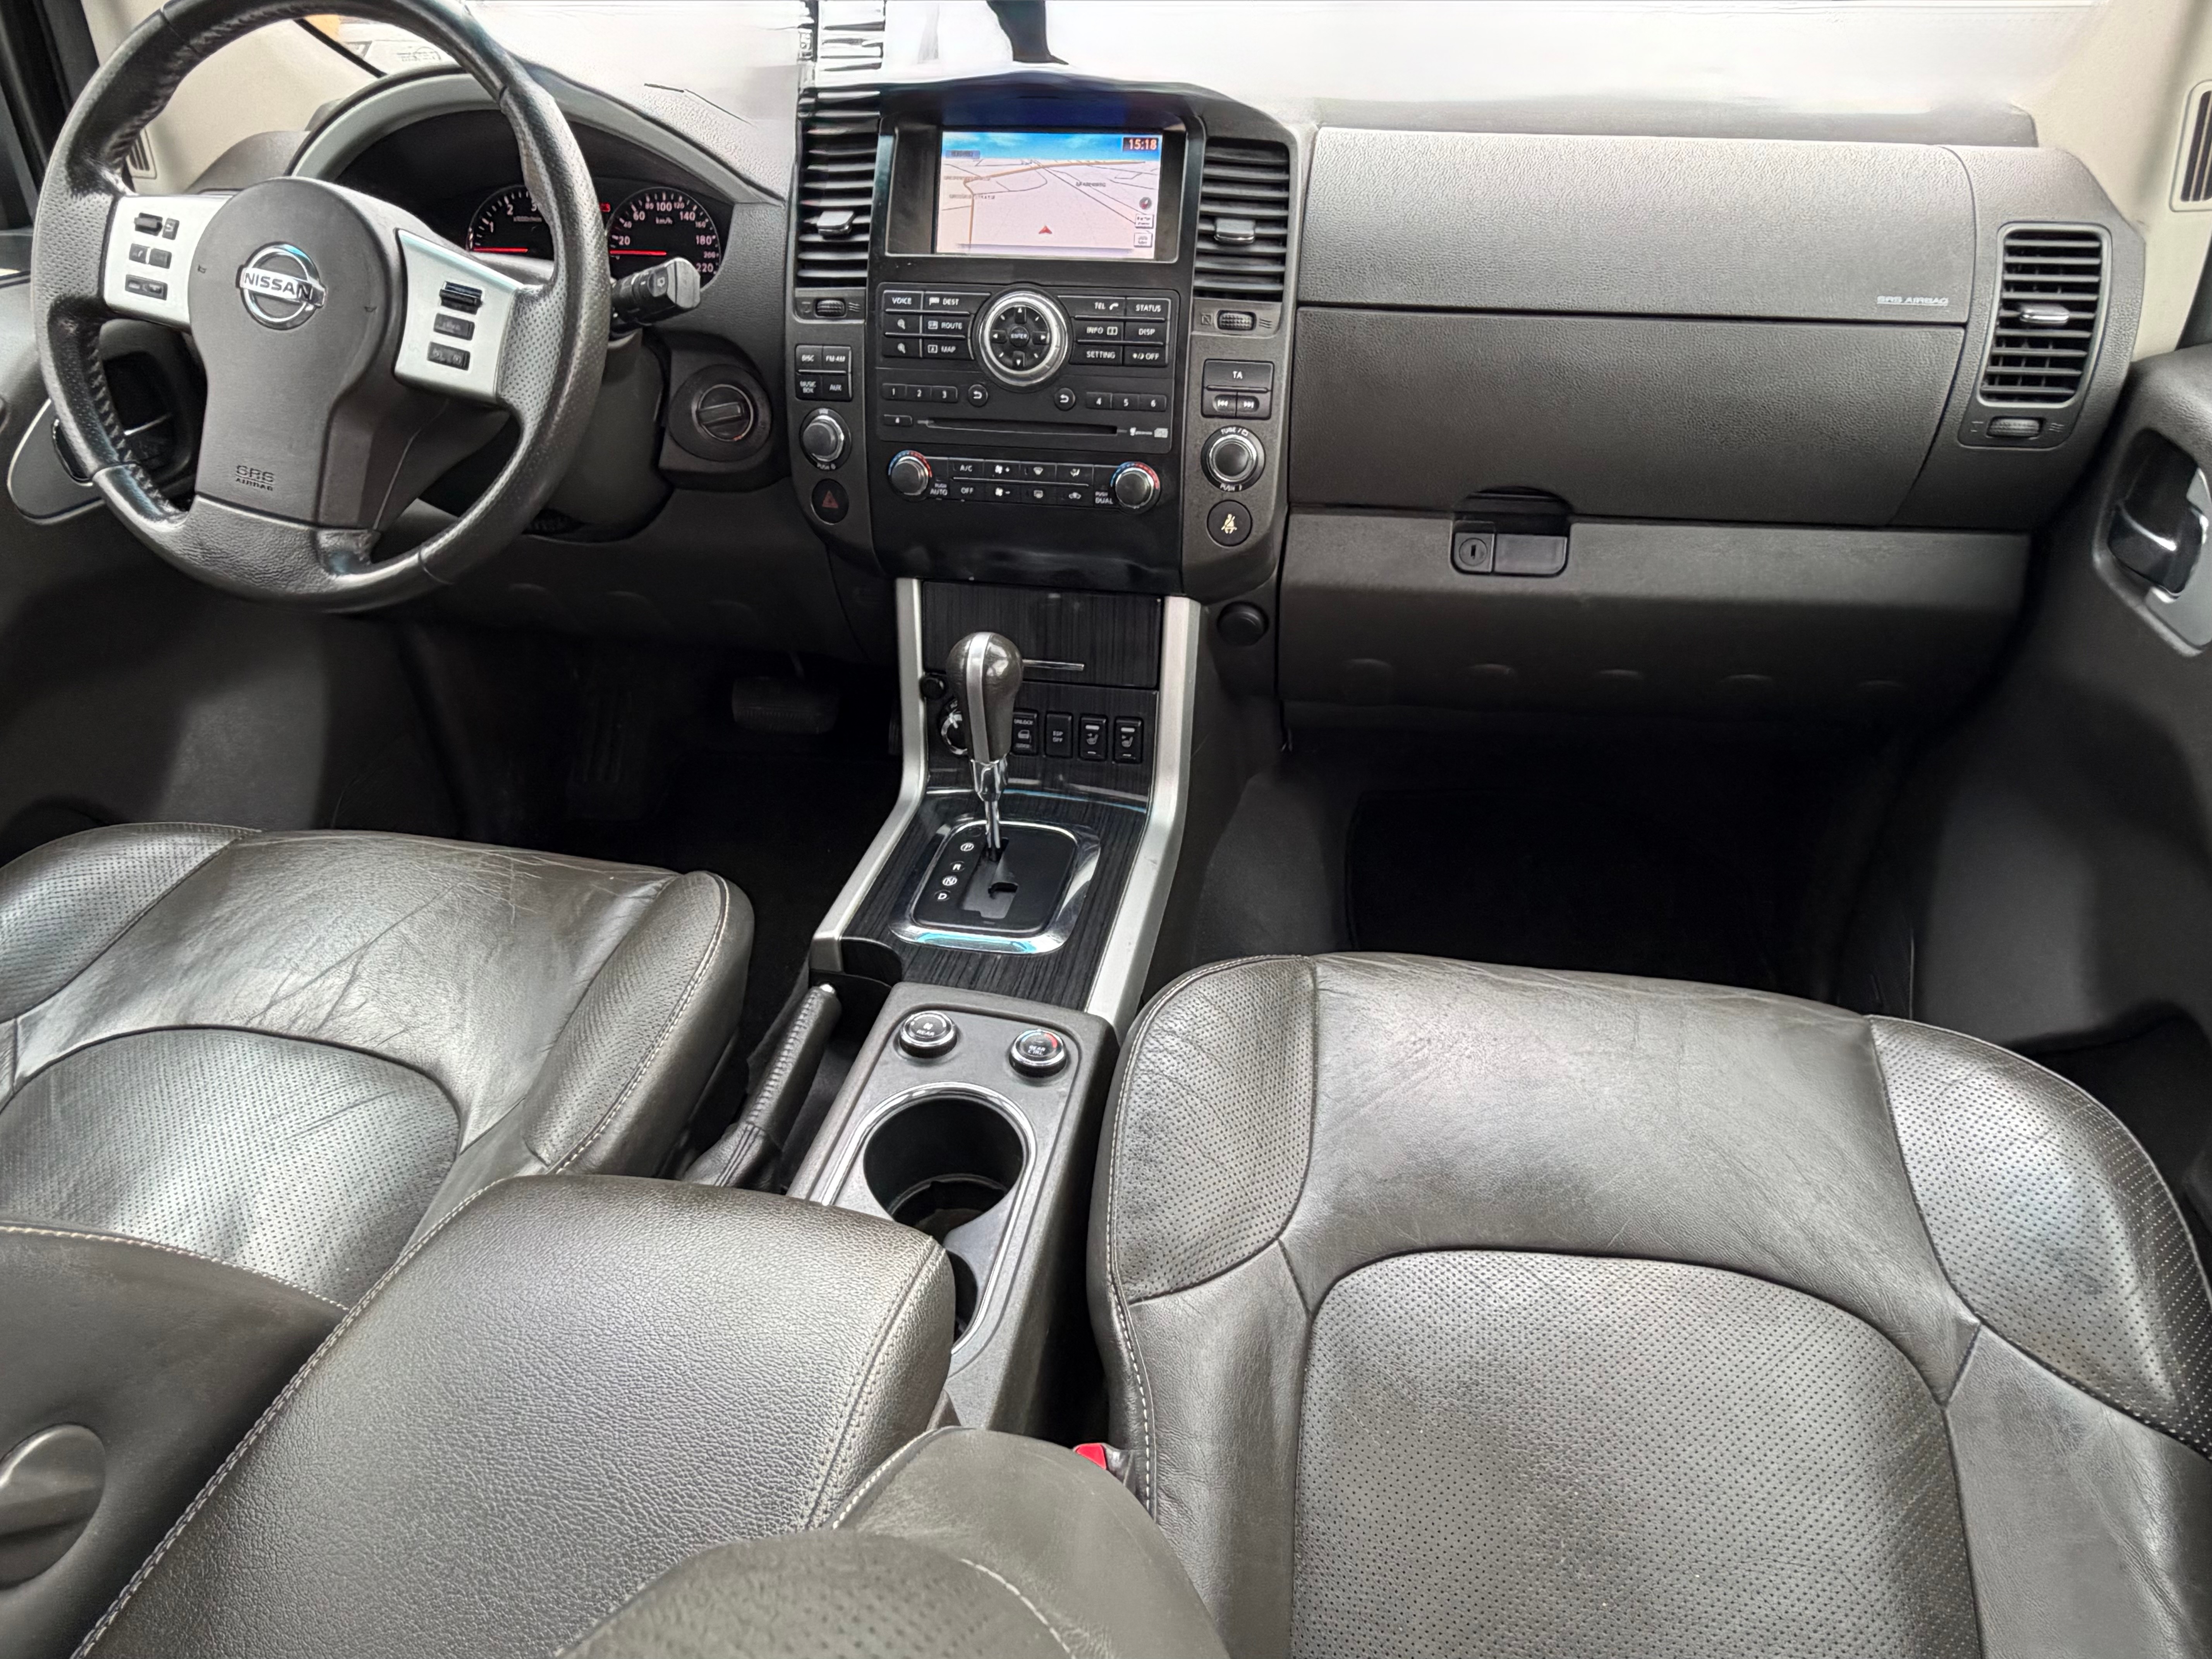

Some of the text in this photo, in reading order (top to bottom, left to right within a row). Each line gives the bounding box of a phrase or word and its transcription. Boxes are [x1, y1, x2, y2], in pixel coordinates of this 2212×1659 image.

[1129, 139, 1157, 150] 15:18
[507, 204, 514, 215] 2
[656, 202, 672, 211] 100
[633, 211, 646, 221] 60
[679, 211, 696, 221] 140
[618, 235, 630, 246] 20
[696, 235, 712, 245] 180
[697, 263, 714, 273] 220
[243, 272, 311, 300] NISSAN
[1233, 371, 1243, 380] TA
[917, 389, 922, 397] 2
[942, 390, 947, 399] 3
[1124, 398, 1129, 407] 5
[236, 465, 274, 483] SRS
[235, 478, 273, 491] AIRBAG
